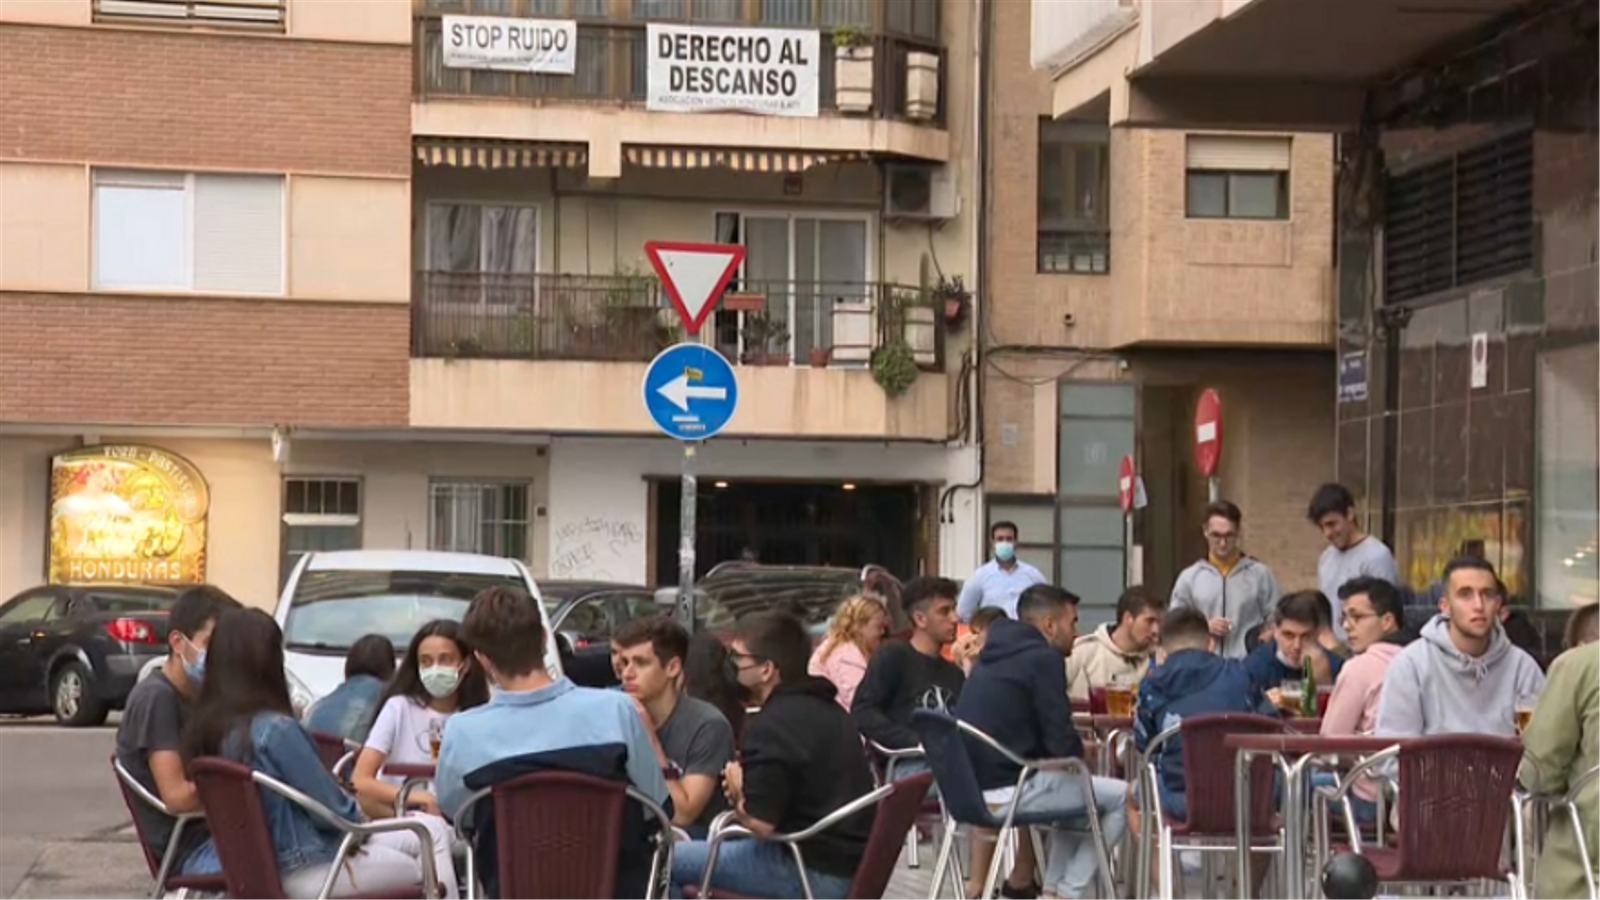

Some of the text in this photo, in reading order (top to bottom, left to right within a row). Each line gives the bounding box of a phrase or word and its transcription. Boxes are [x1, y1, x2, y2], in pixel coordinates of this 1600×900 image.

[451, 23, 568, 52] STOP RUIDO
[658, 33, 808, 65] DERECHO AL
[669, 65, 797, 97] DESCANSO
[69, 560, 181, 580] HONDURAS
